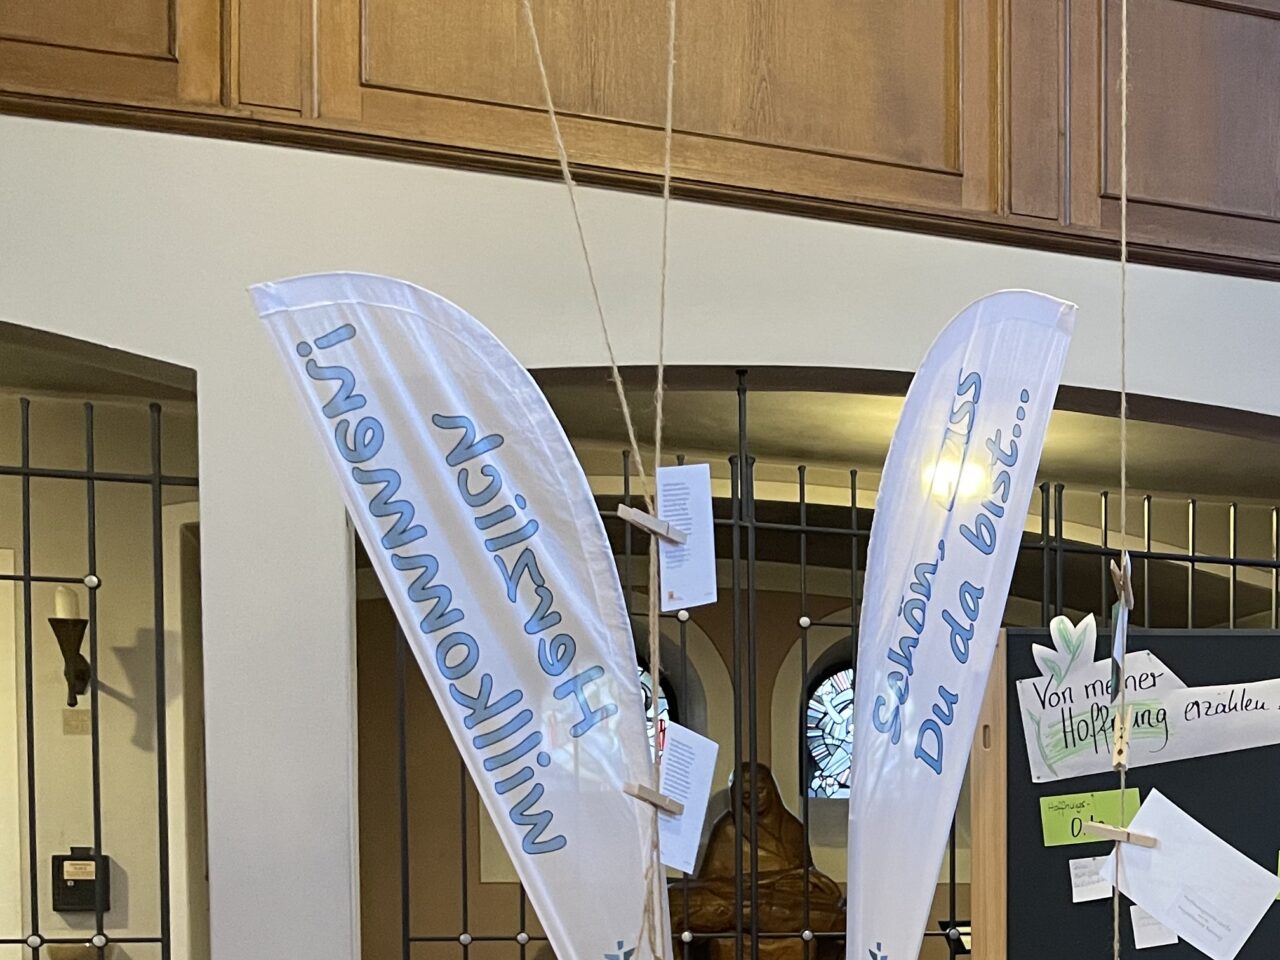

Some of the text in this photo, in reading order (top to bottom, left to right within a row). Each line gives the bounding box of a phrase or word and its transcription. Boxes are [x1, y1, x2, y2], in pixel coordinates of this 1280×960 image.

[872, 539, 945, 745] Schön,
[914, 684, 959, 776] Du
[942, 579, 985, 665] da
[1032, 672, 1164, 710] Von mener
